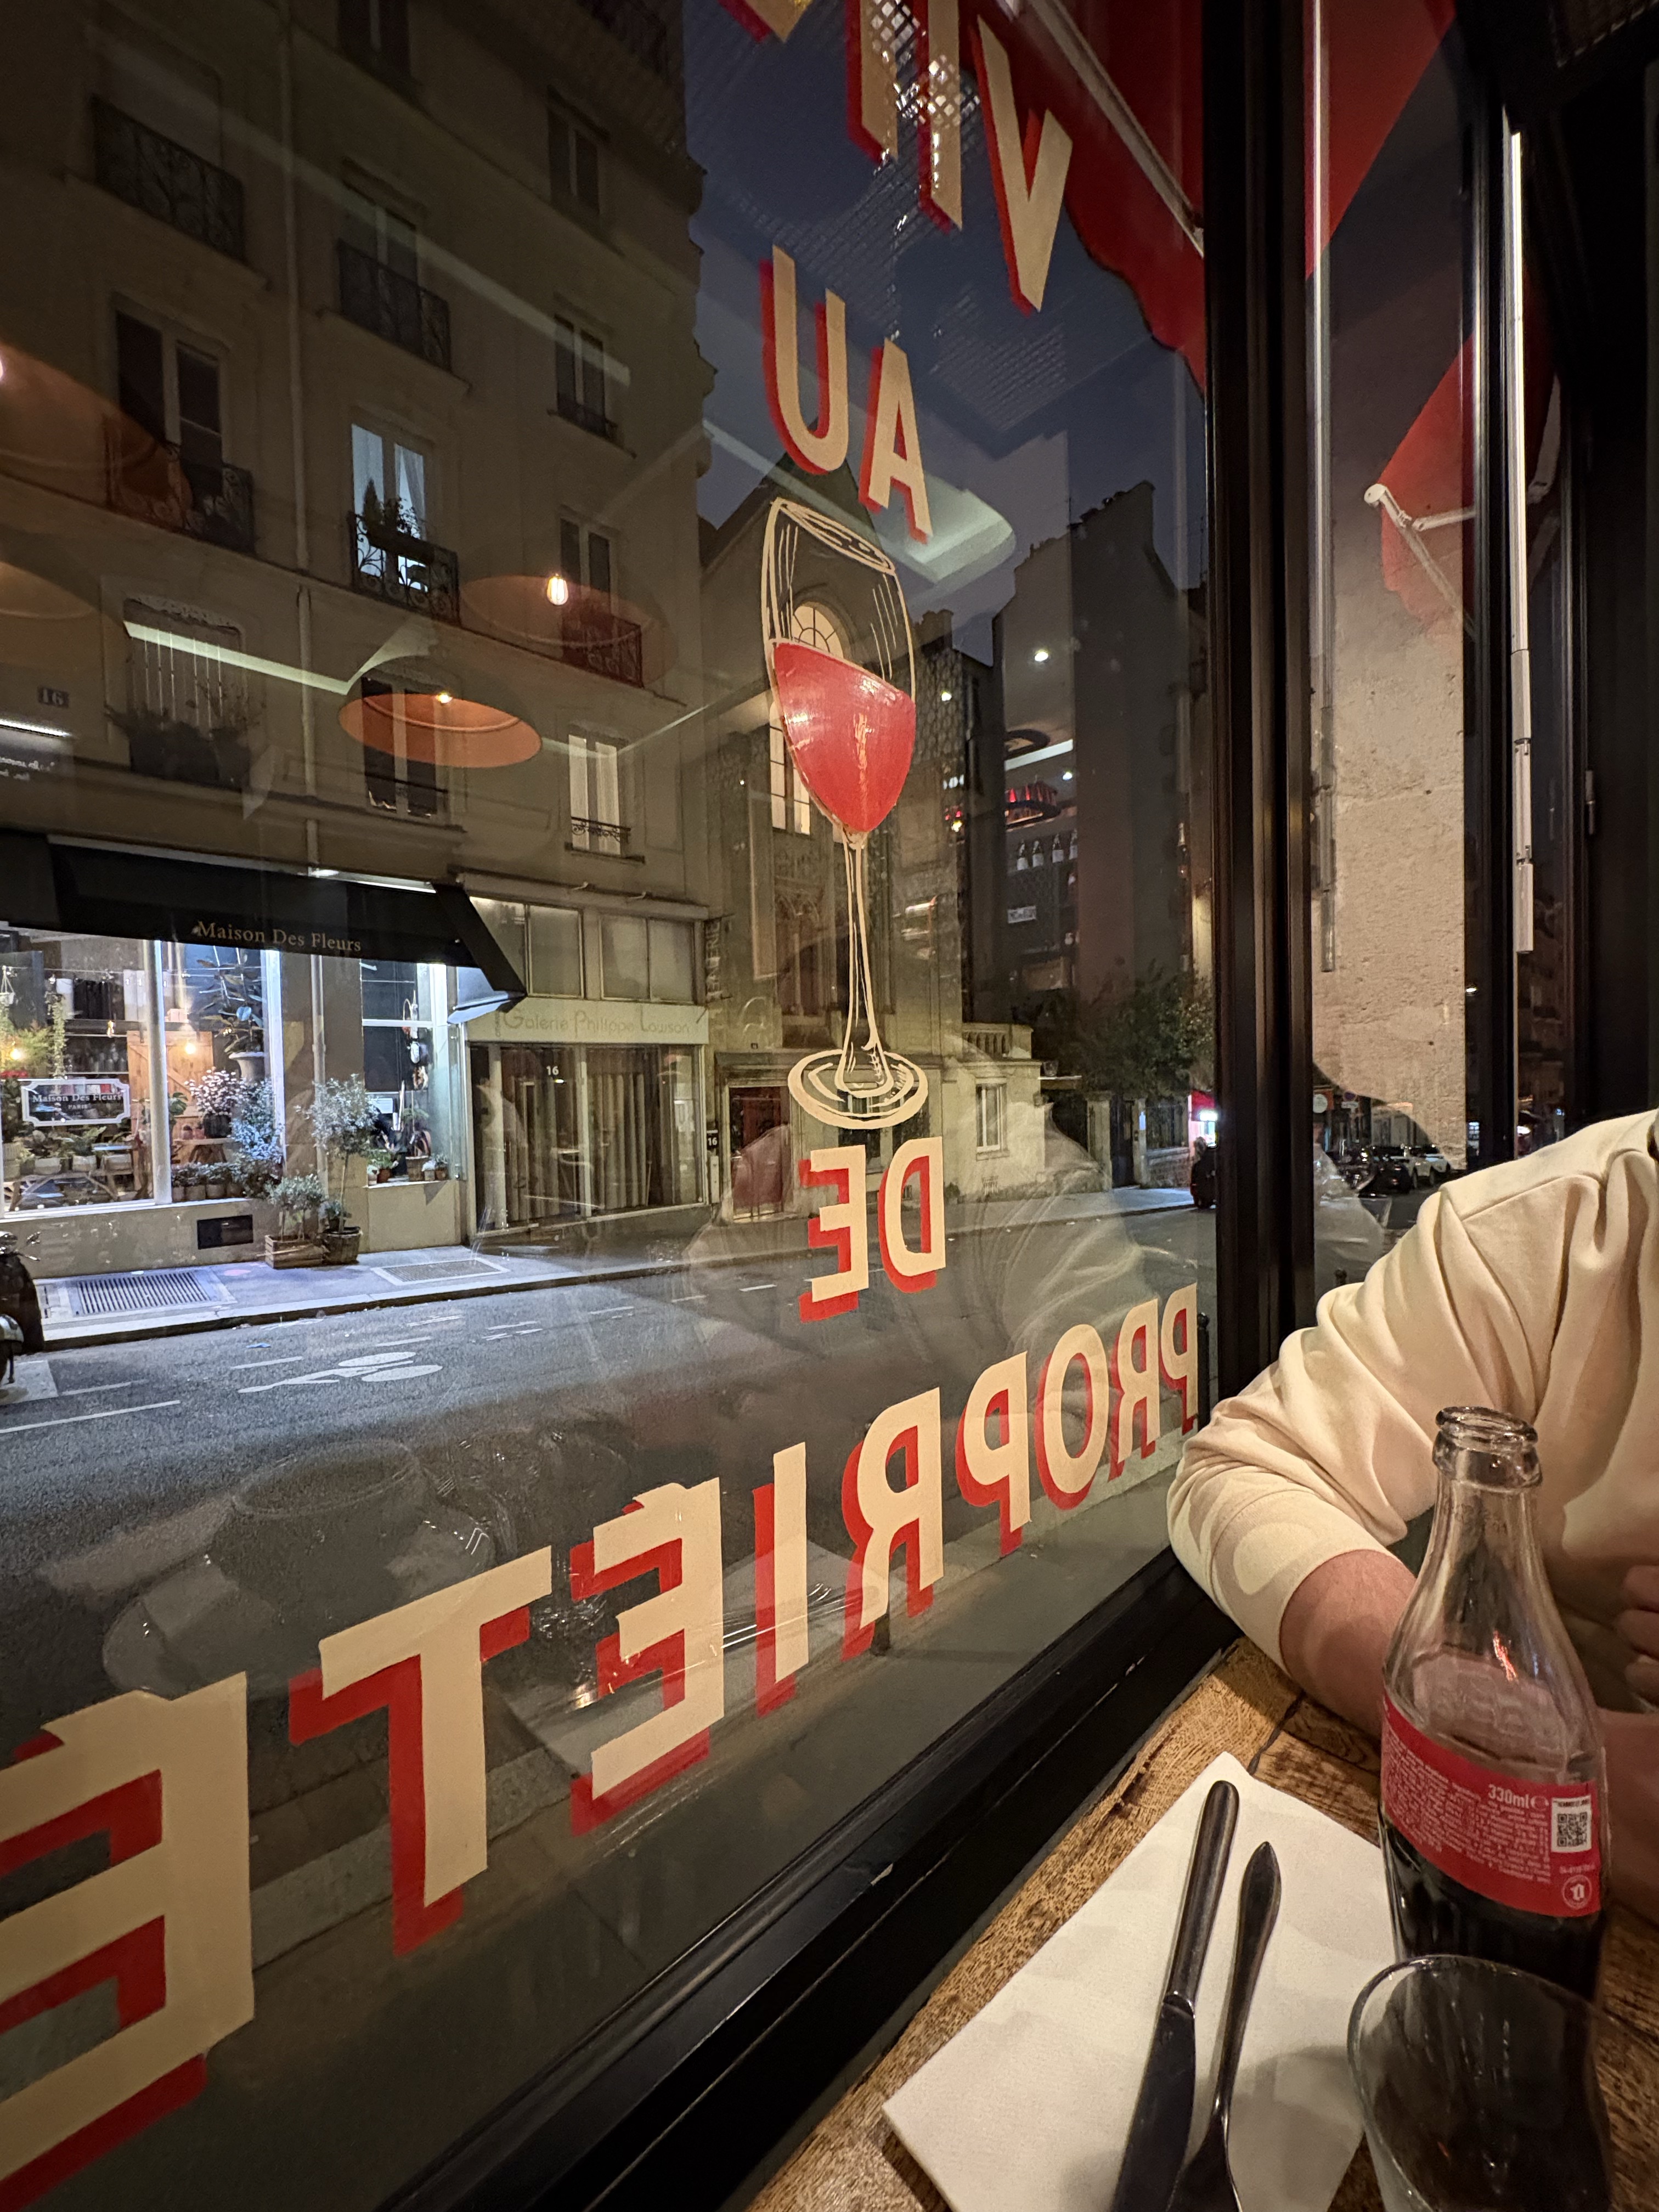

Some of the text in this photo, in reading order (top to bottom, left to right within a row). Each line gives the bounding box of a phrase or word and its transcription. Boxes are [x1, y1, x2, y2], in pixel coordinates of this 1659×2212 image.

[43, 689, 64, 706] 16
[196, 920, 362, 952] Maison Des Fleurs
[503, 1008, 568, 1031] Galerie
[640, 1005, 690, 1034] Lawson
[546, 1066, 560, 1076] 16
[708, 1137, 718, 1146] 16
[1487, 1783, 1530, 1809] 330ml
